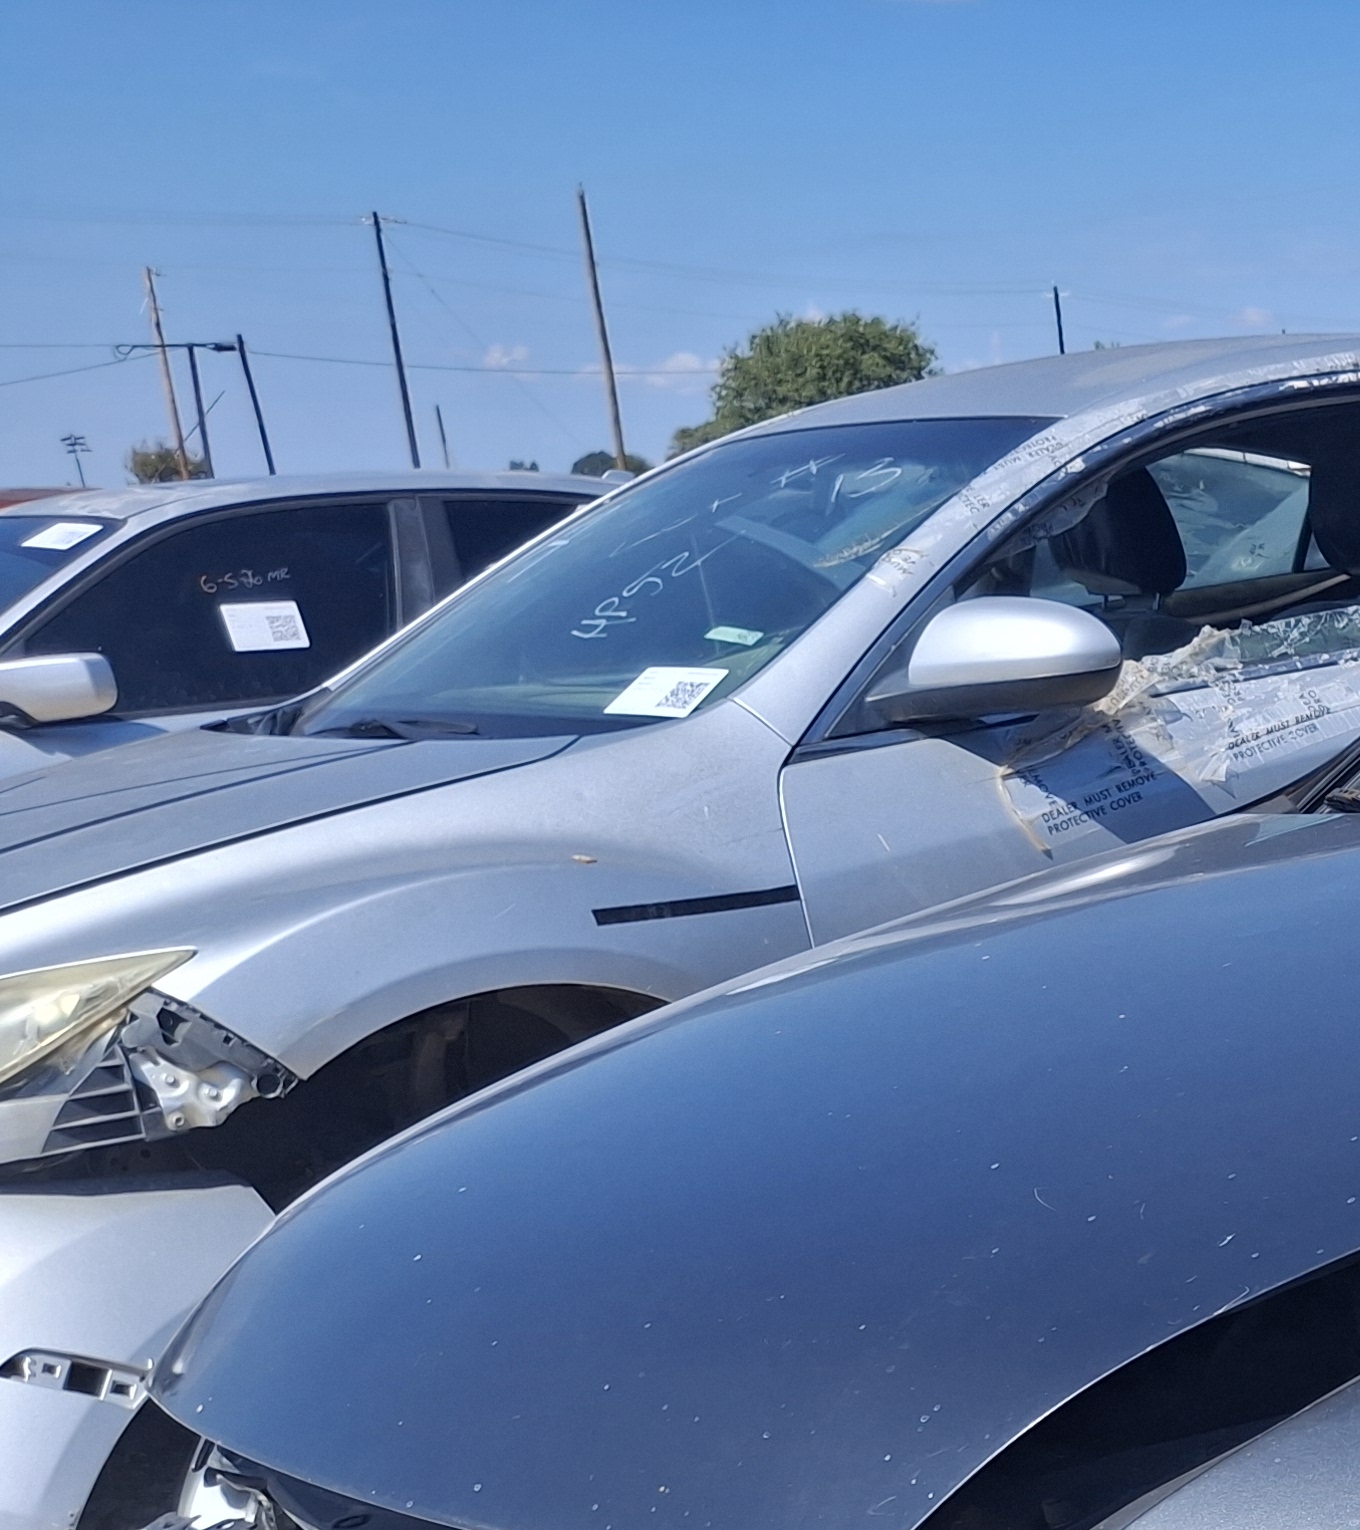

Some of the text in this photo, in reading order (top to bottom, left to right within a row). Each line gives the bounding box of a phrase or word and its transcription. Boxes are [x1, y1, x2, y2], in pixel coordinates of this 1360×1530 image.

[1041, 770, 1159, 823] DEALER MUST REMOVE
[1047, 791, 1143, 835] PROTECTIVE COVER
